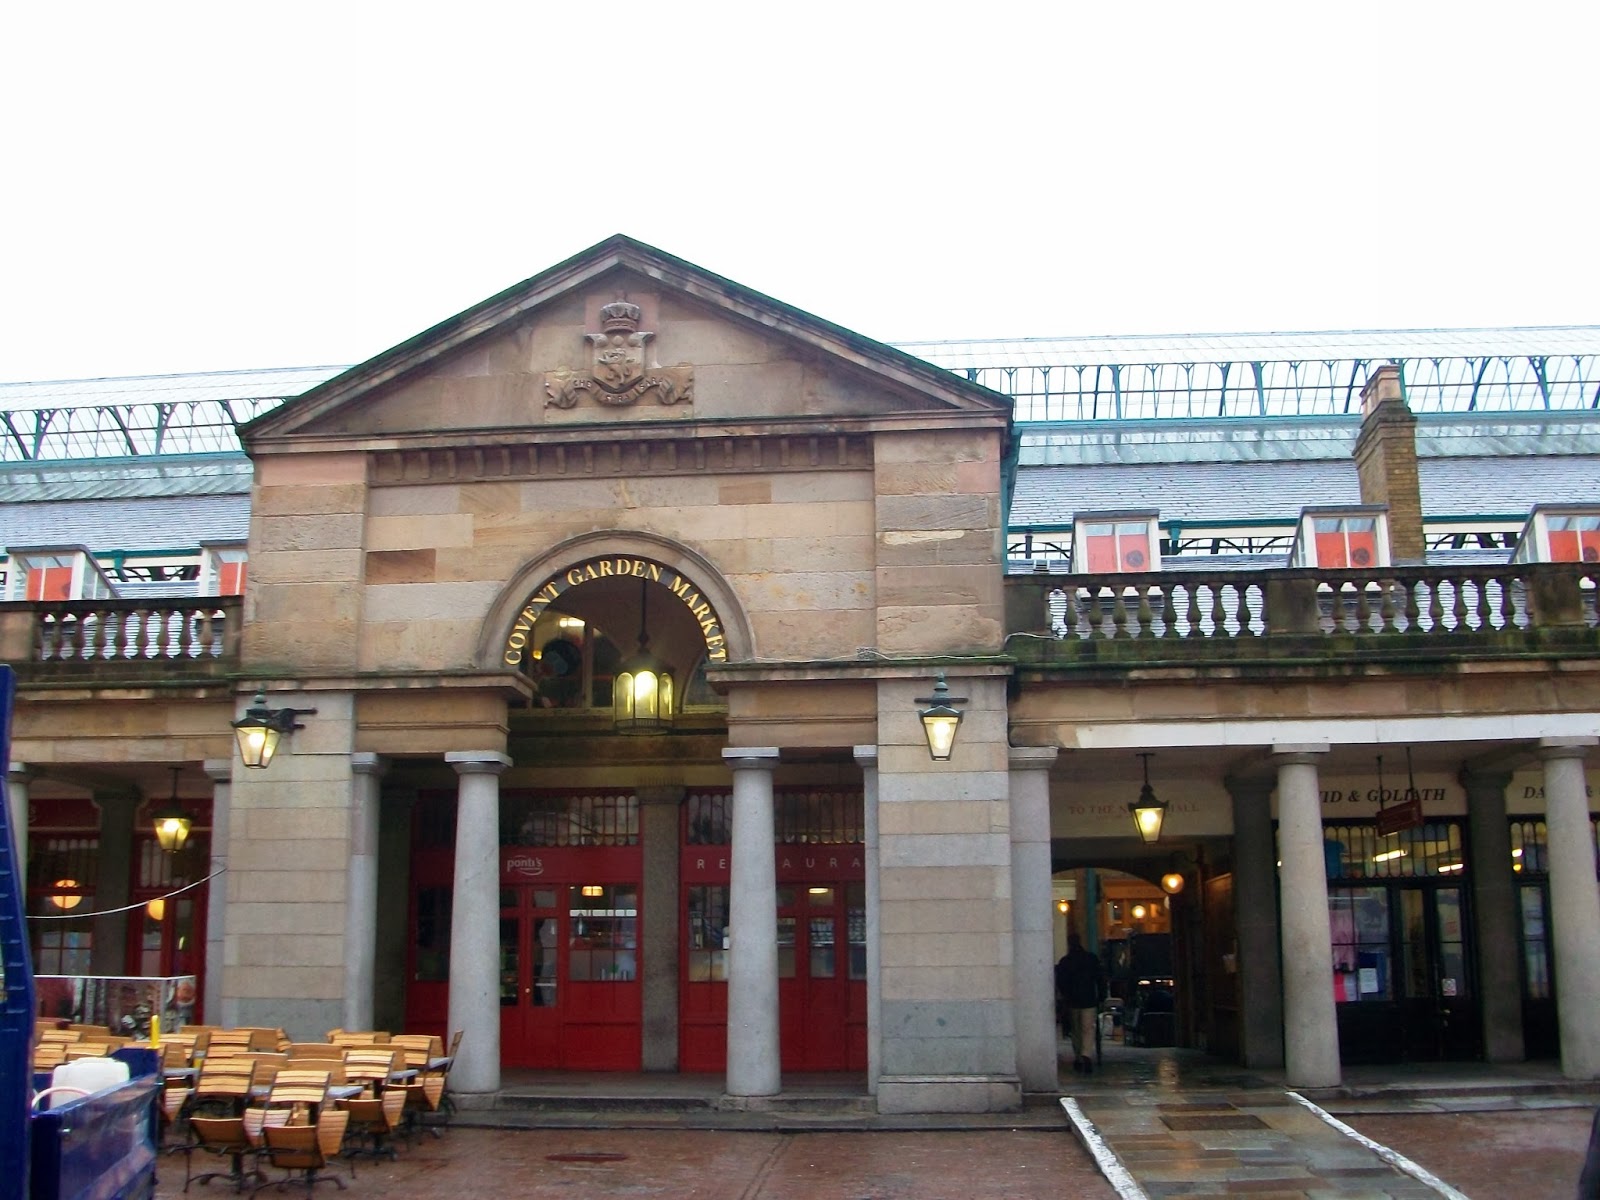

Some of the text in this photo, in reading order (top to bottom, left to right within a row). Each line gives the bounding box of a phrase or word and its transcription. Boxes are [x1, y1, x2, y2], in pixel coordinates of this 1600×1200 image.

[505, 559, 728, 665] COVENT GARDEN MARKET
[1348, 790, 1361, 802] &
[1367, 788, 1446, 801] GOLIATH
[507, 856, 543, 873] ponti's
[696, 857, 861, 870] REAURA
